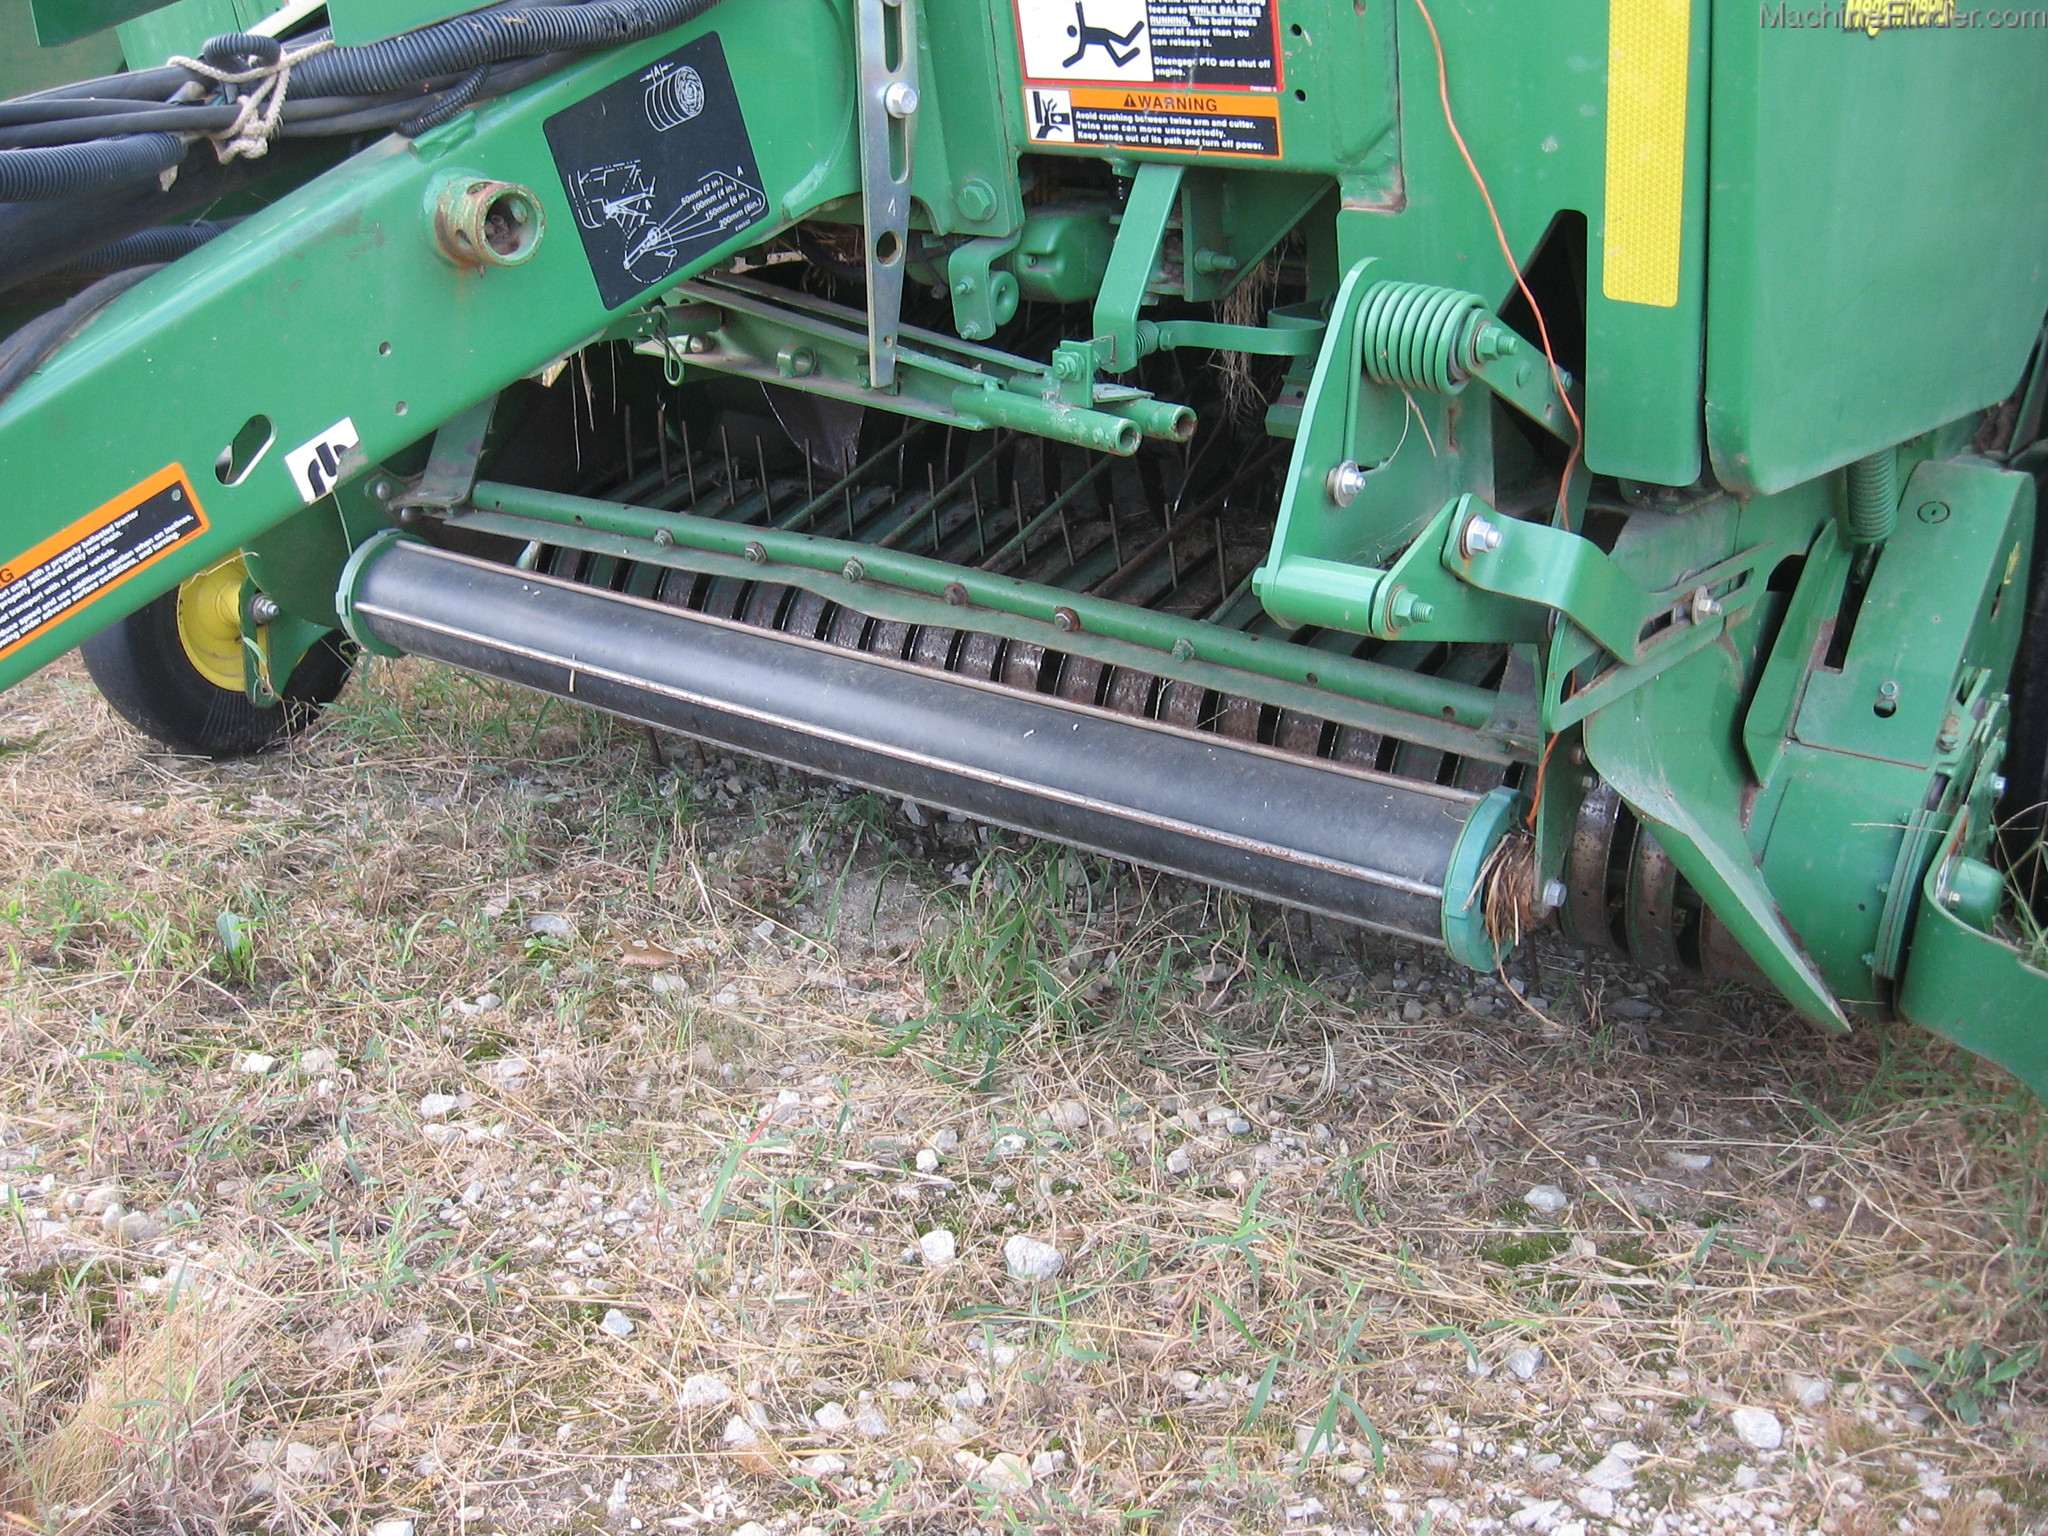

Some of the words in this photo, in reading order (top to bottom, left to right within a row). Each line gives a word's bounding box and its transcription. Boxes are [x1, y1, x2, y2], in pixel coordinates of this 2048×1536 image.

[1188, 5, 1216, 15] WHILE
[1219, 5, 1249, 16] BALER
[1251, 5, 1261, 16] IS
[1150, 24, 1184, 36] material
[1185, 25, 1210, 36] faster
[1212, 28, 1232, 37] than
[1233, 29, 1250, 38] you
[1169, 38, 1201, 47] release
[654, 65, 660, 77] A
[1199, 57, 1217, 67] PTO
[1219, 58, 1235, 67] and
[1237, 59, 1256, 68] shut
[1258, 59, 1270, 68] off
[1154, 67, 1186, 77] engine.
[1137, 95, 1217, 112] WARNING
[1075, 111, 1097, 120] Avoid
[1098, 113, 1133, 124] crushing
[1169, 116, 1192, 126] twine
[1211, 119, 1227, 128] and
[1228, 120, 1256, 129] cutter.
[1076, 121, 1100, 130] Twine
[1139, 126, 1162, 134] move
[1164, 127, 1226, 139] unexpectedly.
[1077, 130, 1097, 141] Keep
[1099, 132, 1123, 142] hands
[1140, 134, 1149, 143] of
[1151, 135, 1162, 144] its
[1164, 136, 1182, 146] path
[1184, 137, 1200, 146] and
[1221, 139, 1234, 148] off
[1235, 141, 1264, 150] power.
[737, 166, 743, 176] A
[645, 199, 652, 210] A
[681, 189, 703, 206] 50mm
[692, 195, 717, 212] 100mm
[705, 202, 730, 220] 150mm
[719, 209, 744, 228] 200mm
[10, 578, 27, 593] only
[27, 568, 45, 582] with
[50, 545, 81, 570] properly
[80, 524, 115, 549] ballasted
[114, 510, 138, 529] tractor
[31, 565, 64, 590] attached
[62, 551, 86, 570] safety
[85, 543, 100, 555] tow
[100, 530, 123, 546] chain.
[8, 591, 44, 617] transport
[43, 582, 61, 595] with
[66, 564, 88, 582] motor
[88, 548, 117, 567] vehicle.
[18, 606, 42, 626] speed
[42, 597, 57, 611] and
[56, 589, 71, 601] use
[71, 565, 108, 592] additional
[107, 550, 135, 570] caution
[133, 538, 154, 553] when
[153, 531, 165, 541] on
[19, 616, 42, 634] under
[40, 598, 72, 620] adverse
[69, 581, 99, 602] surface
[138, 546, 153, 560] and
[150, 529, 180, 551] turning.
